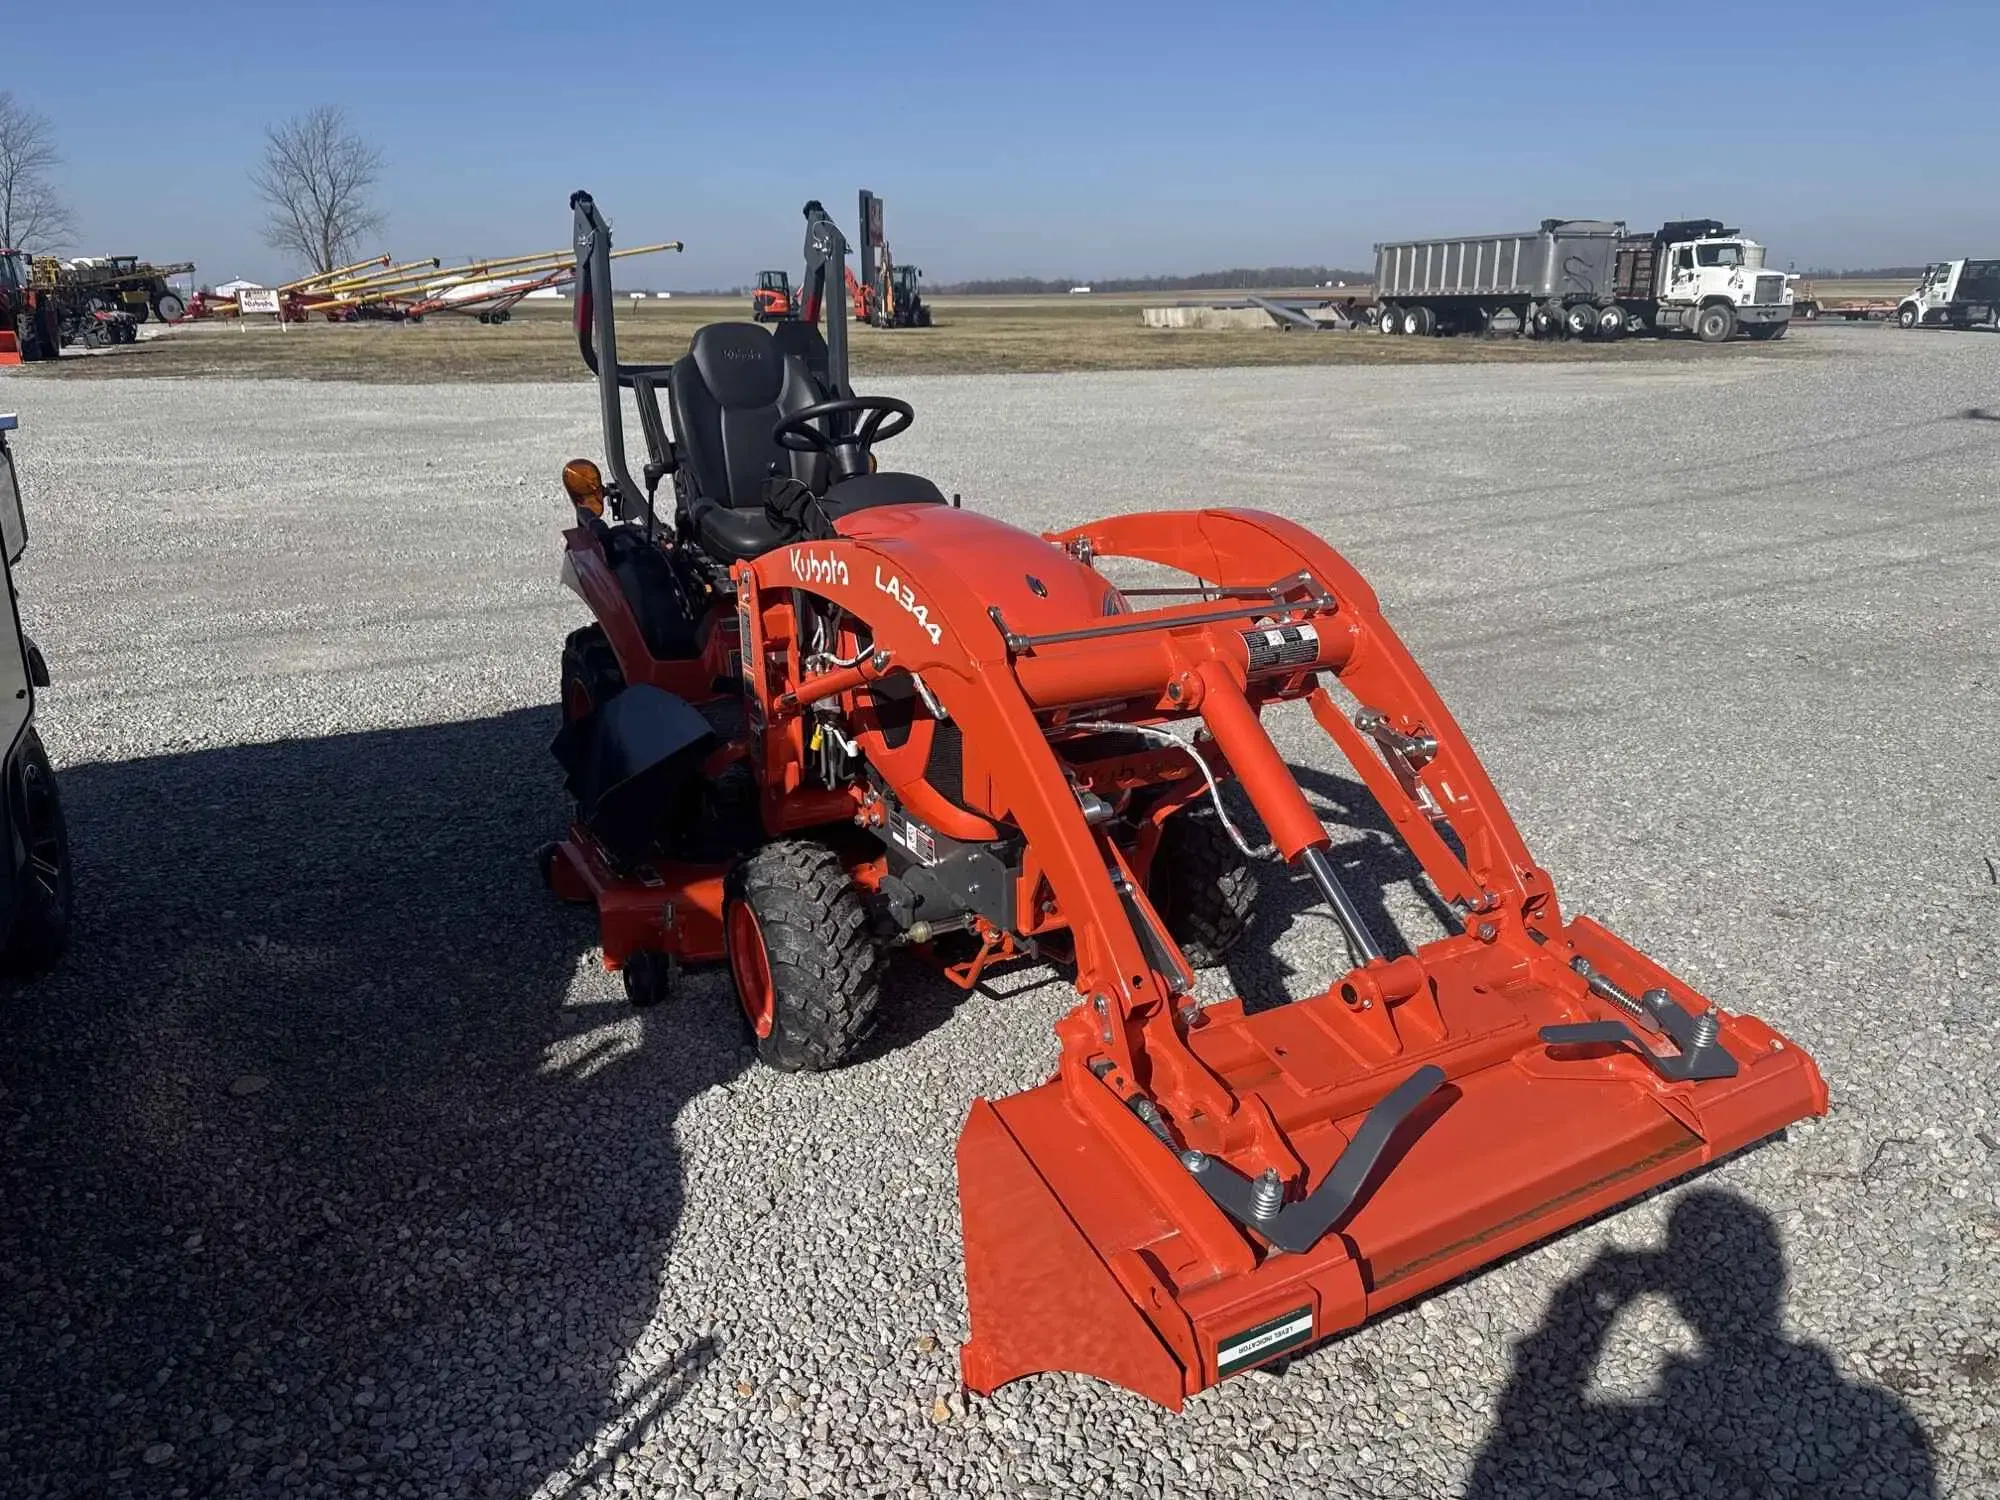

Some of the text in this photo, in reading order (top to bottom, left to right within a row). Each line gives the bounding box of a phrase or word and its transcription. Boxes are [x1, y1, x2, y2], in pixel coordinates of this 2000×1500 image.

[789, 548, 849, 586] Kubota
[875, 565, 943, 646] LA344
[1238, 1326, 1294, 1354] LEVEL INDICATOR
